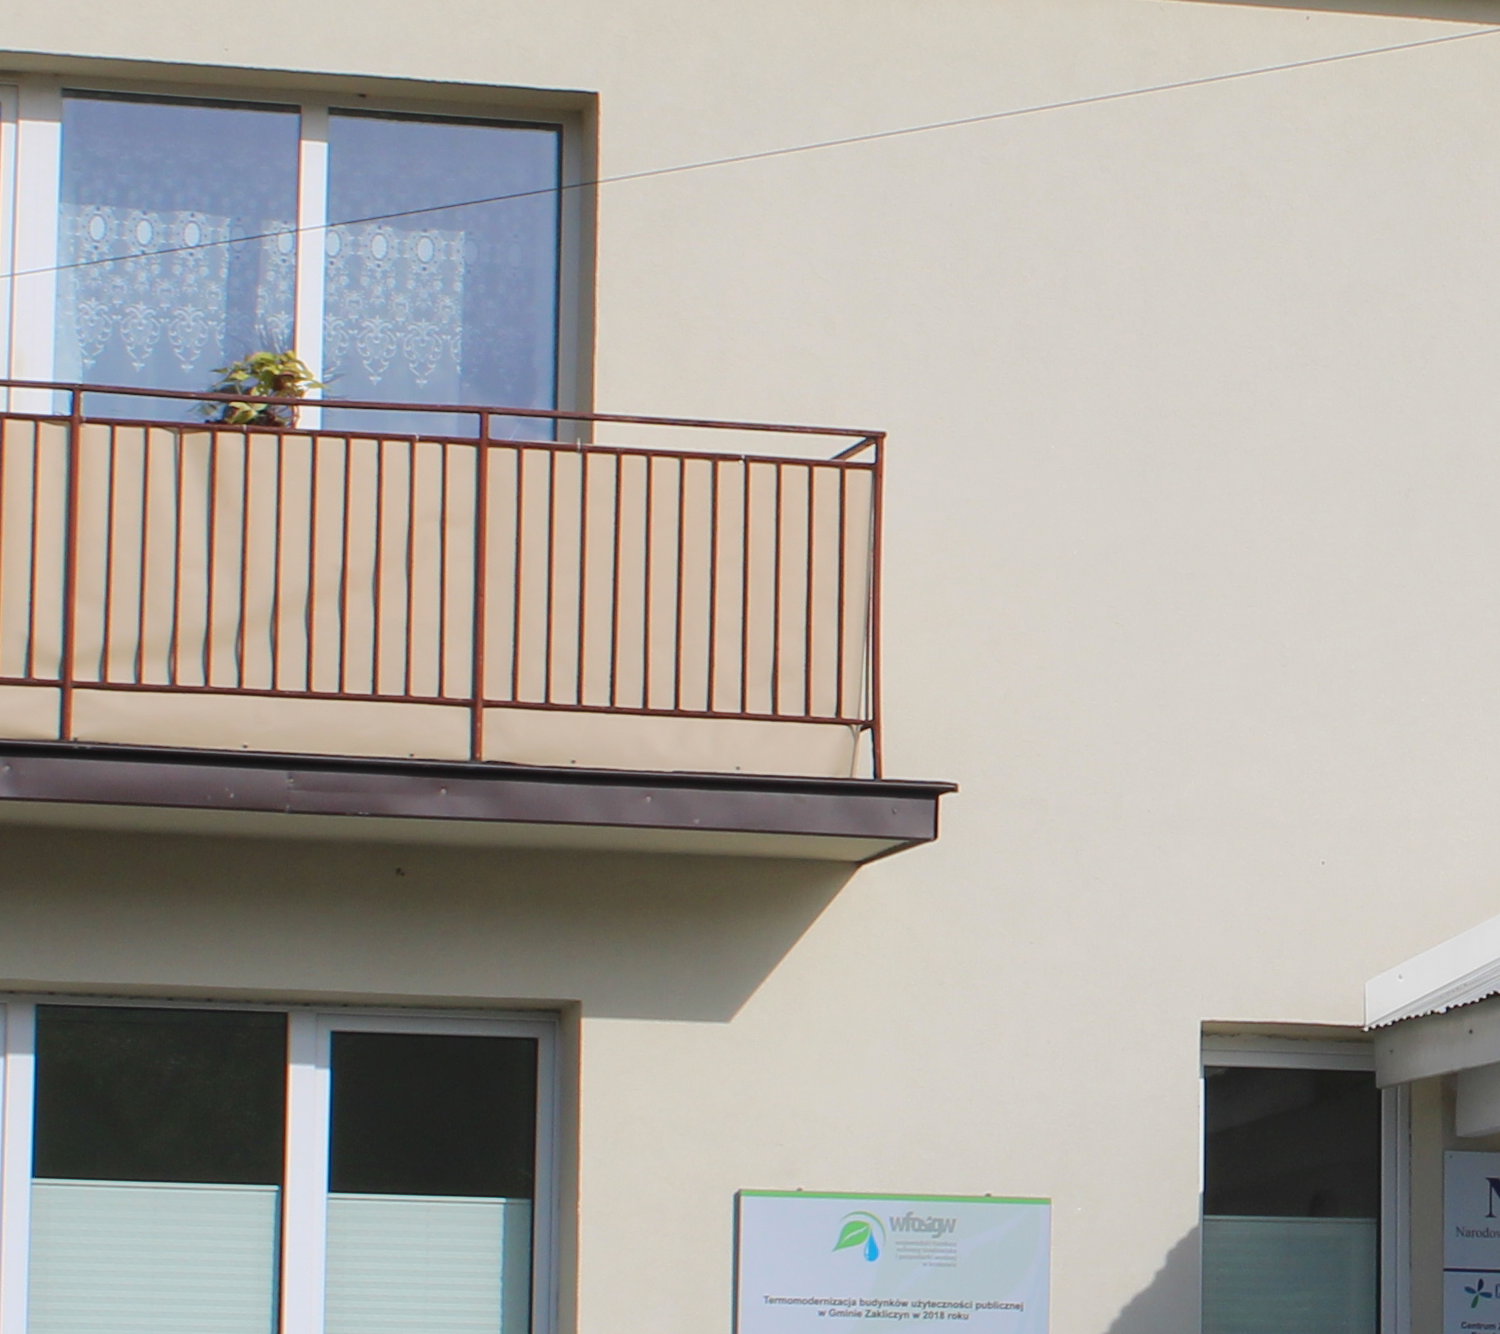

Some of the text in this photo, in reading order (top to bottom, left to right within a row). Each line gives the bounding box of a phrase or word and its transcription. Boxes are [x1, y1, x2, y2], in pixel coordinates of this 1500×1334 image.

[763, 1295, 1024, 1312] Termomodernizacja budynków użyteczności publicznej
[829, 1308, 862, 1318] Gminie
[865, 1309, 910, 1321] Zakliczyn
[947, 1312, 969, 1320] roku
[1461, 1321, 1496, 1331] Centrum
